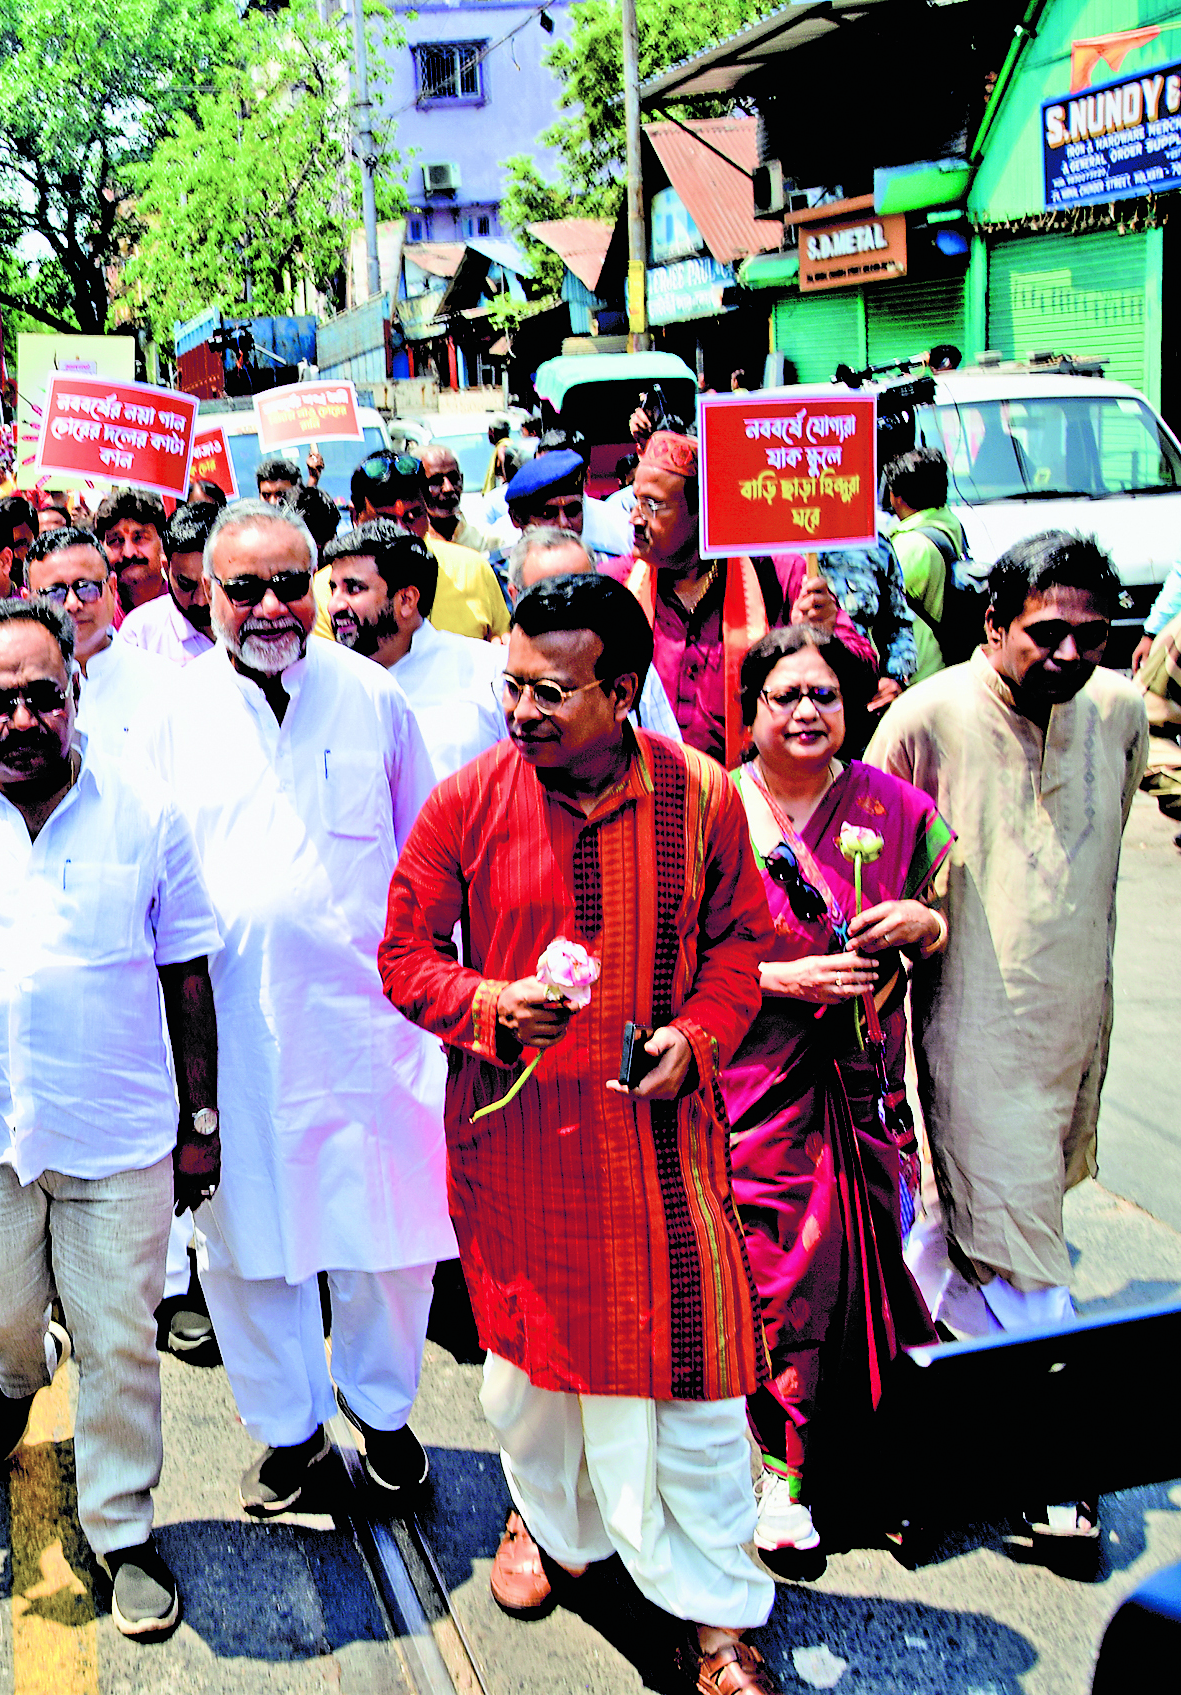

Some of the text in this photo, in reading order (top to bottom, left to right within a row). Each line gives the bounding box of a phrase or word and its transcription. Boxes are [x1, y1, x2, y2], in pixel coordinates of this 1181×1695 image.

[1046, 74, 1164, 149] S.NUNDY
[1109, 141, 1143, 163] ORDER
[56, 392, 187, 433] নববর্ষের নয়া গান
[742, 408, 856, 445] নববর্ষে যোগ্যরা
[50, 416, 185, 457] চোরের দলের কাটা
[99, 446, 134, 469] কান
[764, 445, 842, 478] যাক স্কুলে
[738, 469, 778, 505] বাড়ি
[779, 476, 818, 504] ছাড়া
[791, 506, 821, 534] ঘরে
